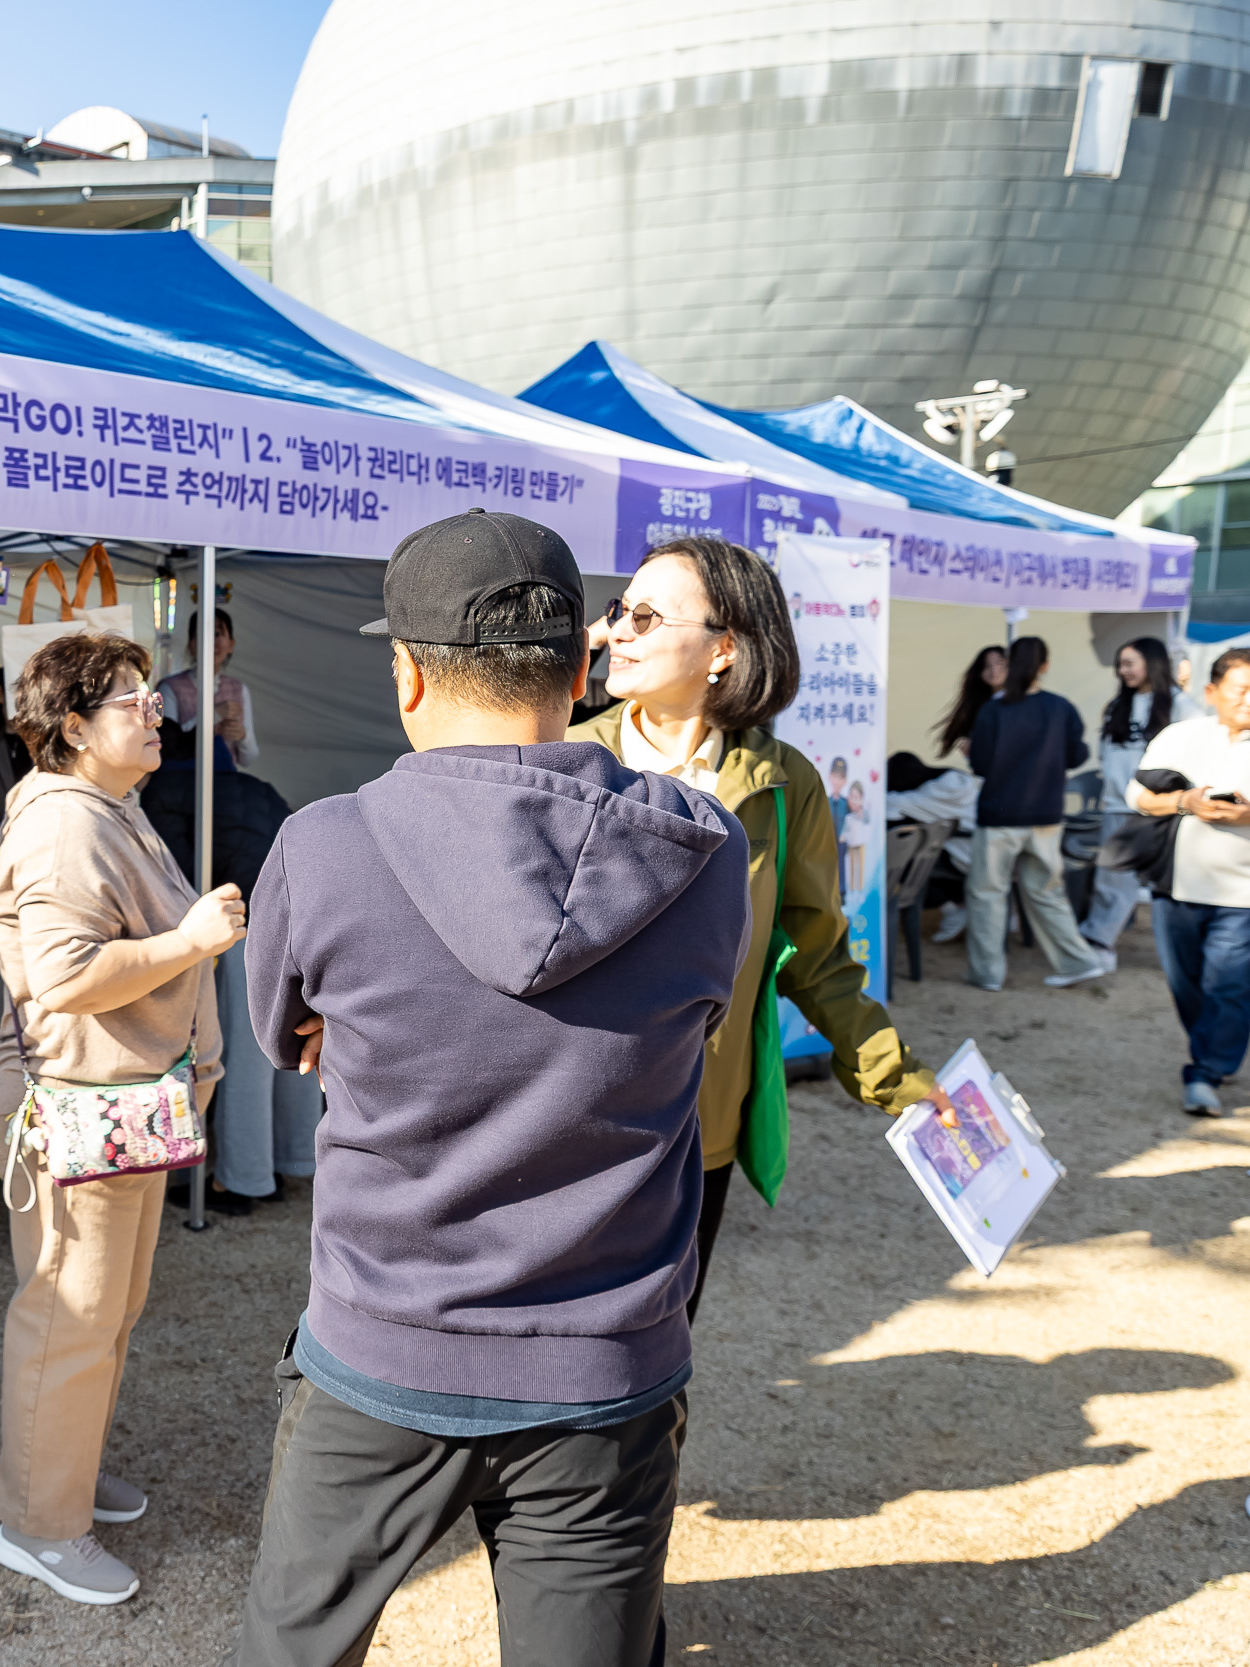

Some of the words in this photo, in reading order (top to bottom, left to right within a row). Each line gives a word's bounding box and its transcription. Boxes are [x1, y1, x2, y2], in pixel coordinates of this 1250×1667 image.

[2, 446, 168, 500] 폴라로이드로
[175, 467, 269, 514] 추억까지
[366, 447, 430, 486] 권리다!
